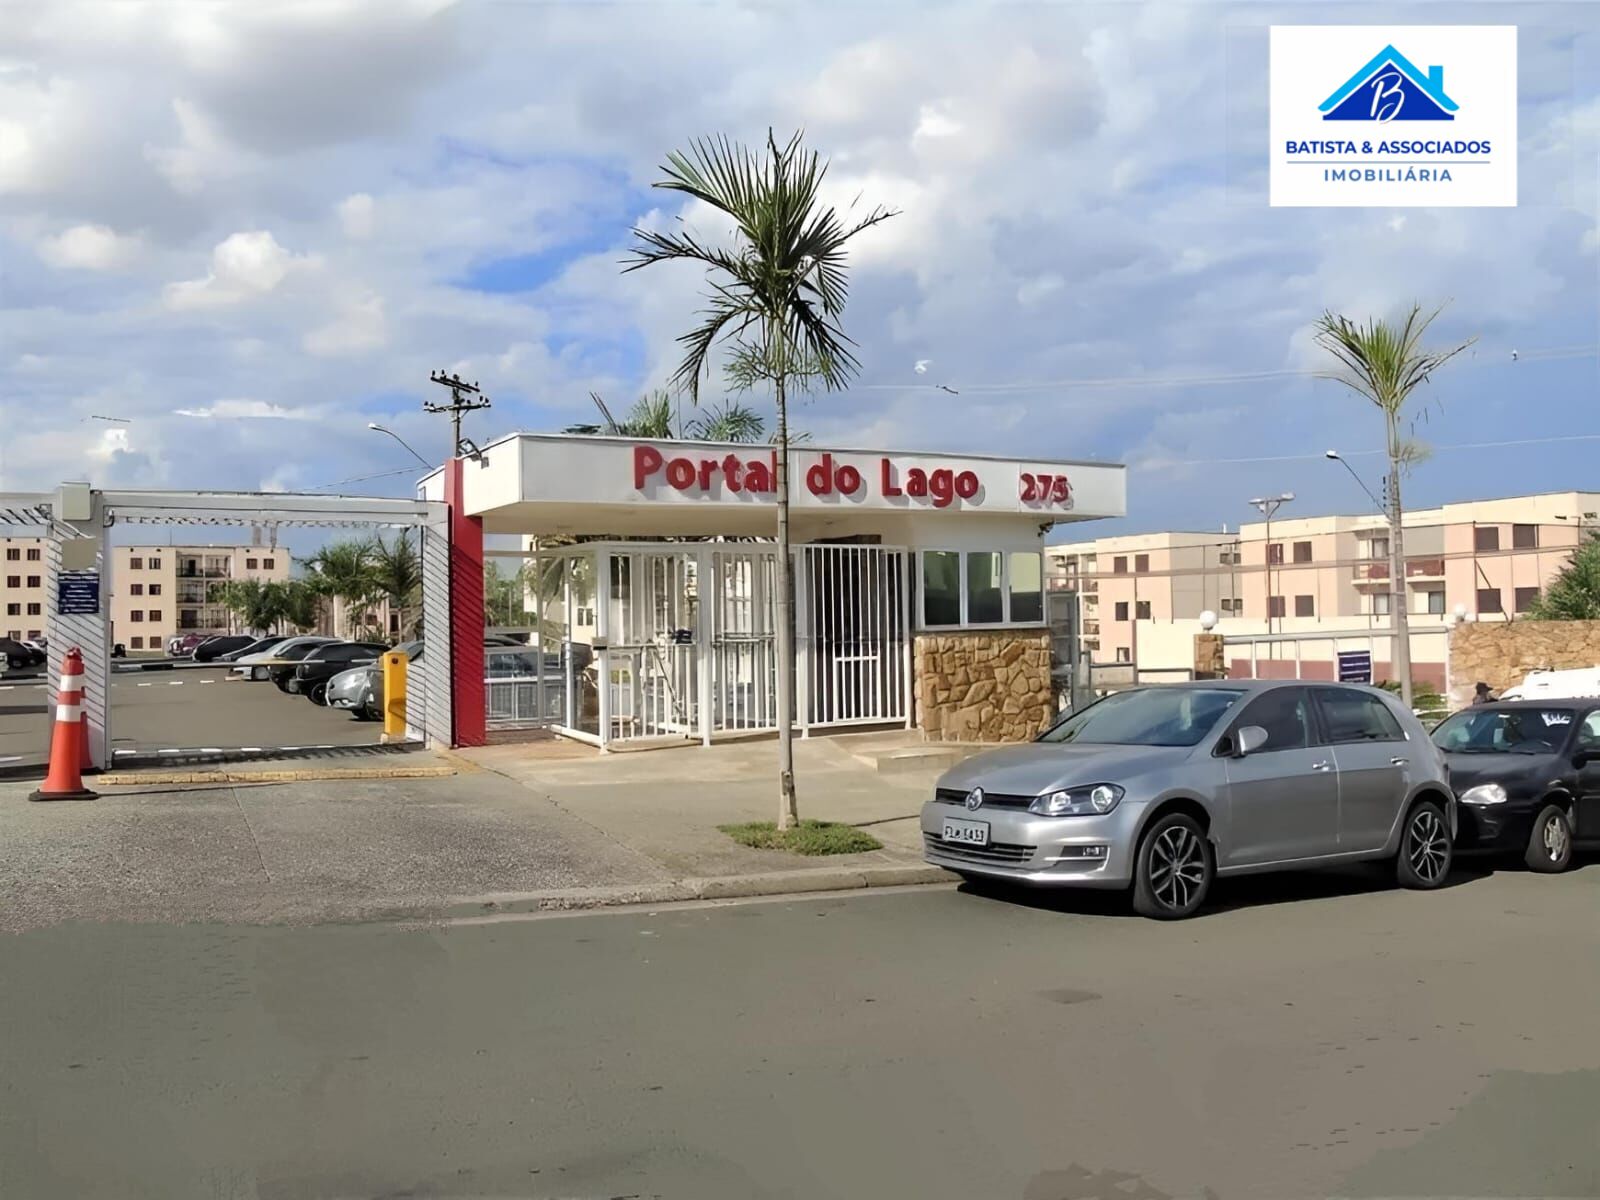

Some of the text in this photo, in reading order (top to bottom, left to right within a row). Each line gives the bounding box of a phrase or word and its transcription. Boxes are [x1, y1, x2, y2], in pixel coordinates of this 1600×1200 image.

[806, 453, 860, 495] do
[881, 458, 979, 508] Lago
[1020, 473, 1069, 502] 275
